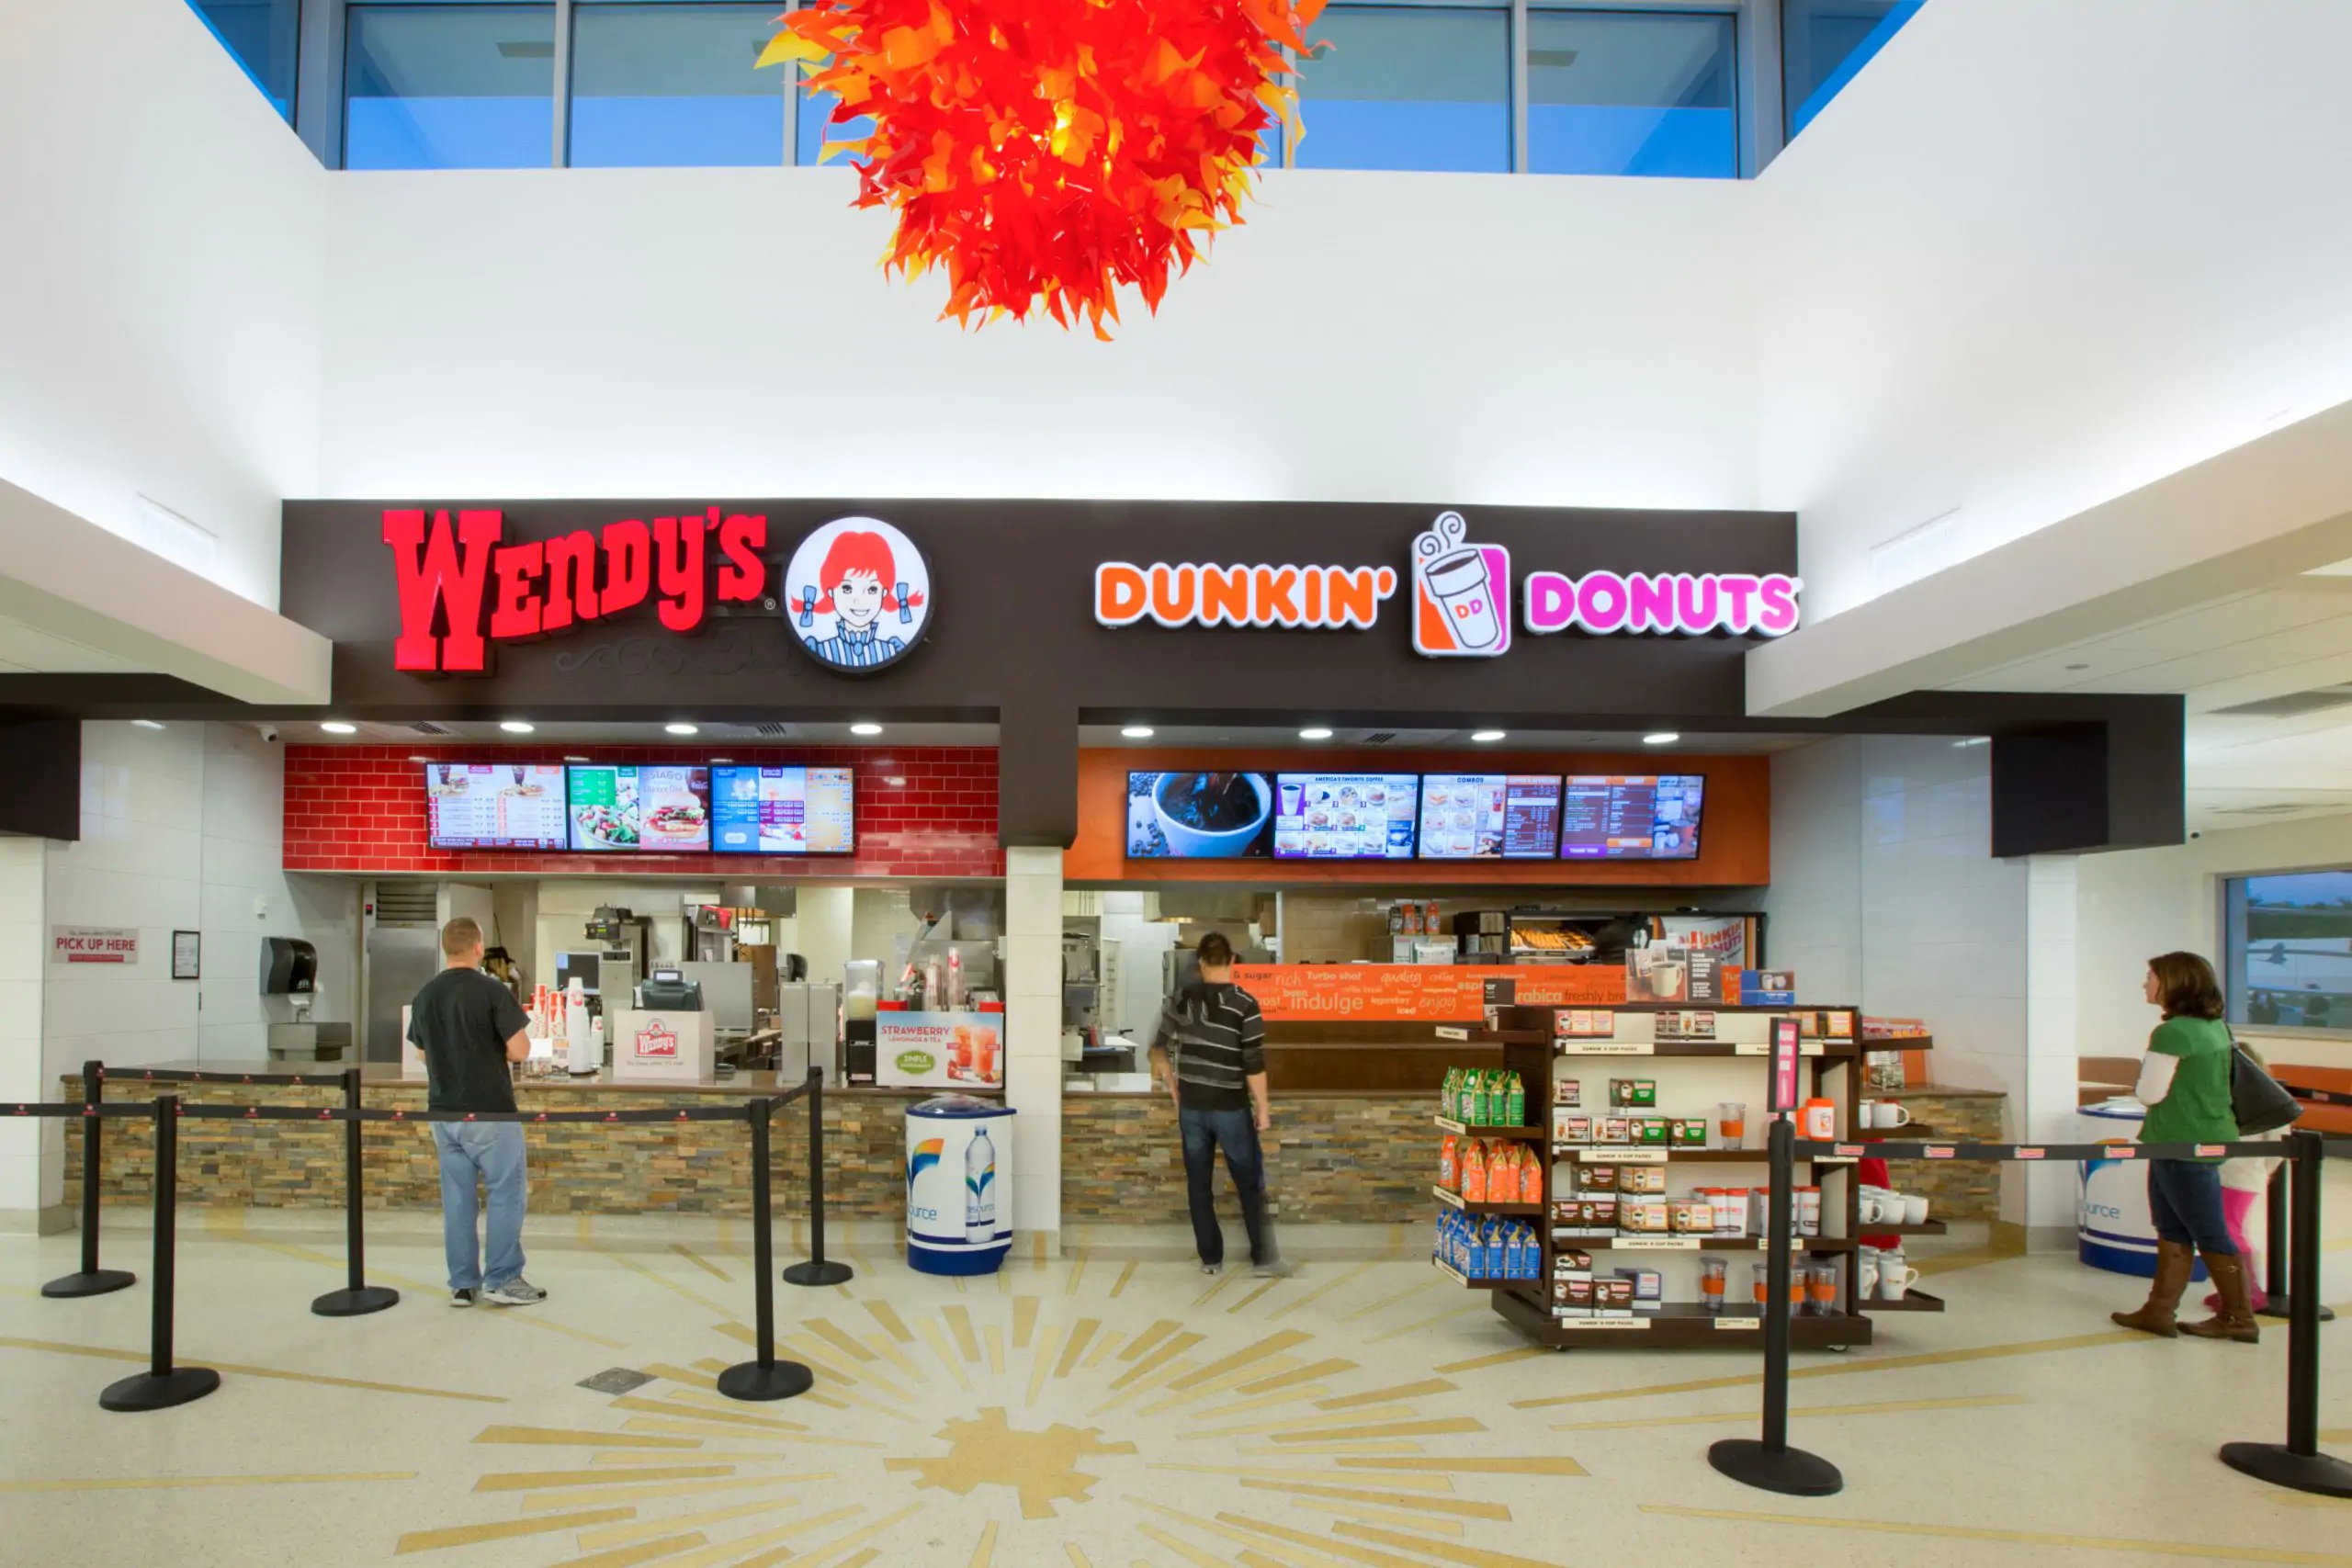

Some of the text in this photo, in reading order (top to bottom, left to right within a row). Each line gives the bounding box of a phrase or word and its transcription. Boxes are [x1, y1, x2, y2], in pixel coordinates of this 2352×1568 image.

[382, 506, 768, 672] Wendy's
[1097, 566, 1798, 631] DUNKIN' DONUTS
[1456, 599, 1483, 618] DD
[56, 937, 136, 952] PICK UP HERE
[1244, 972, 1272, 981] sugar
[1275, 970, 1302, 987] rich
[1306, 970, 1363, 981] Turbo shot
[1380, 968, 1422, 987] quality
[1290, 992, 1363, 1014] indulge
[1516, 989, 1562, 1002] rabica
[1564, 989, 1626, 1003] freshly bre
[1396, 1006, 1417, 1015] iced
[1419, 996, 1457, 1016] enjoy
[881, 1025, 951, 1036] STRAWBERRY
[903, 1055, 928, 1064] SIMPLE
[908, 1208, 937, 1222] ource
[2083, 1203, 2120, 1219] ource
